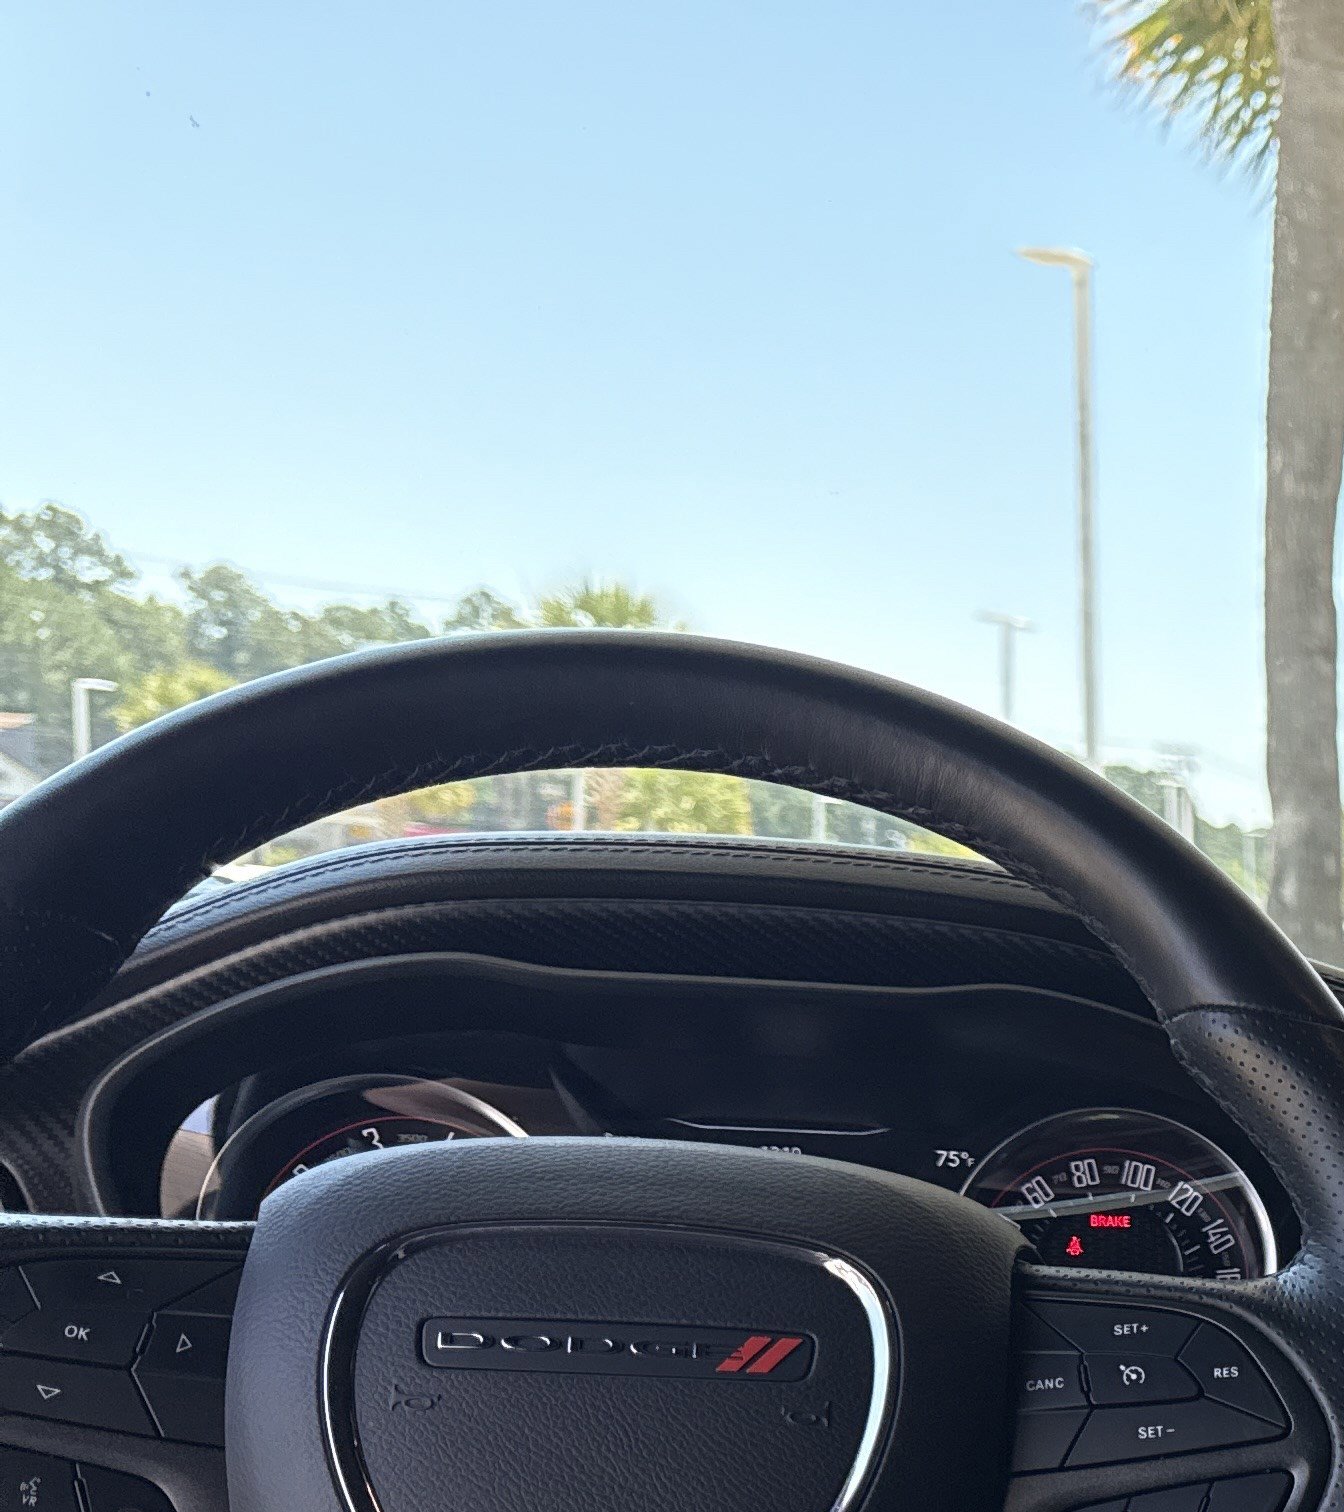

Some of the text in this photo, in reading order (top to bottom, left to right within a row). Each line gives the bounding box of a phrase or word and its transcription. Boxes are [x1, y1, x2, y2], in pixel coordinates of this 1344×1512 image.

[1070, 1158, 1100, 1188] 80
[1121, 1160, 1156, 1191] 100
[1021, 1175, 1055, 1209] 60
[1168, 1180, 1204, 1217] 120
[1089, 1214, 1132, 1228] BRAKE
[1201, 1218, 1236, 1255] 140
[64, 1325, 91, 1341] OK
[436, 1330, 746, 1361] DODGE
[1025, 1377, 1065, 1392] CANC
[1213, 1366, 1239, 1379] RES
